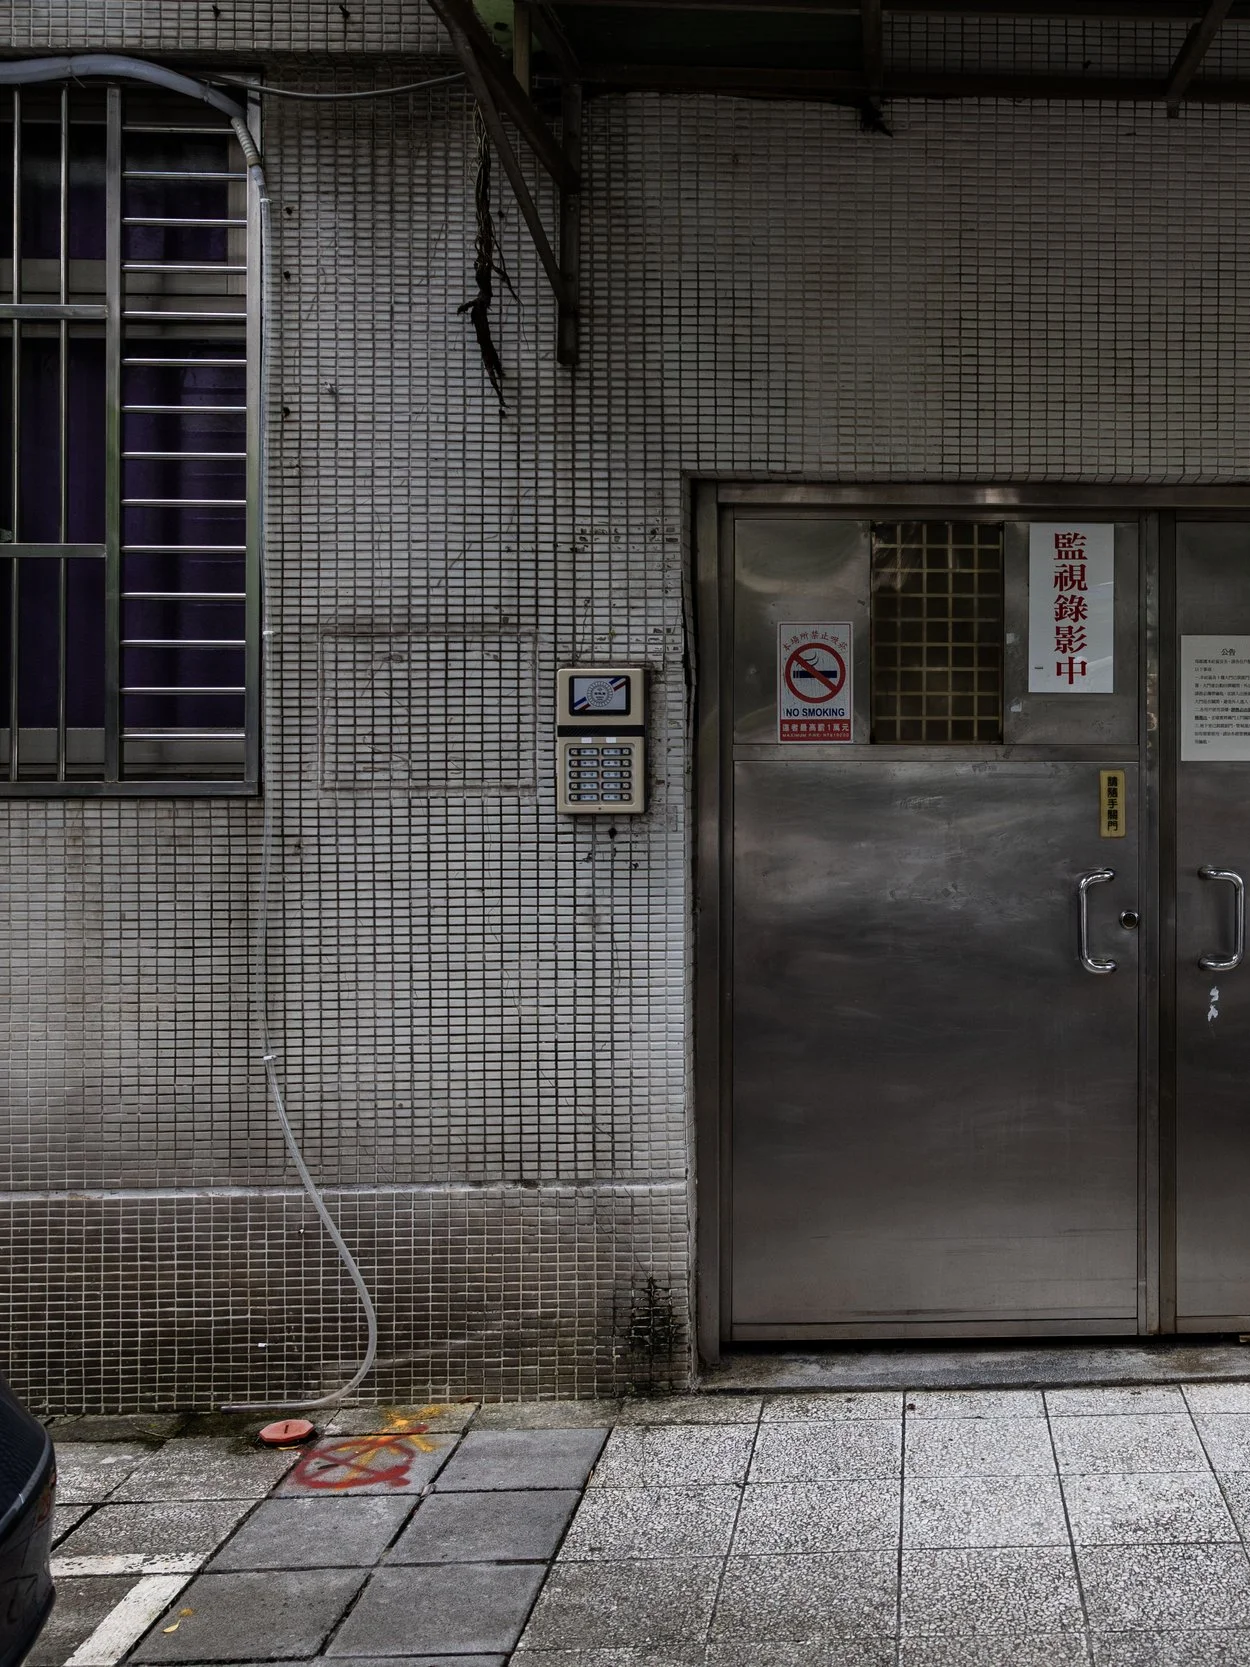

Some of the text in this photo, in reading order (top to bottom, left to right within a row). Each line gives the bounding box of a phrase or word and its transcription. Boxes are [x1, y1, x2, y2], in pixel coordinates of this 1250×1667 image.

[1053, 532, 1088, 685] 監視錄影中
[1221, 648, 1236, 656] 公告
[786, 708, 845, 717] NO SMOKING
[1107, 776, 1119, 831] 請隨手關門
